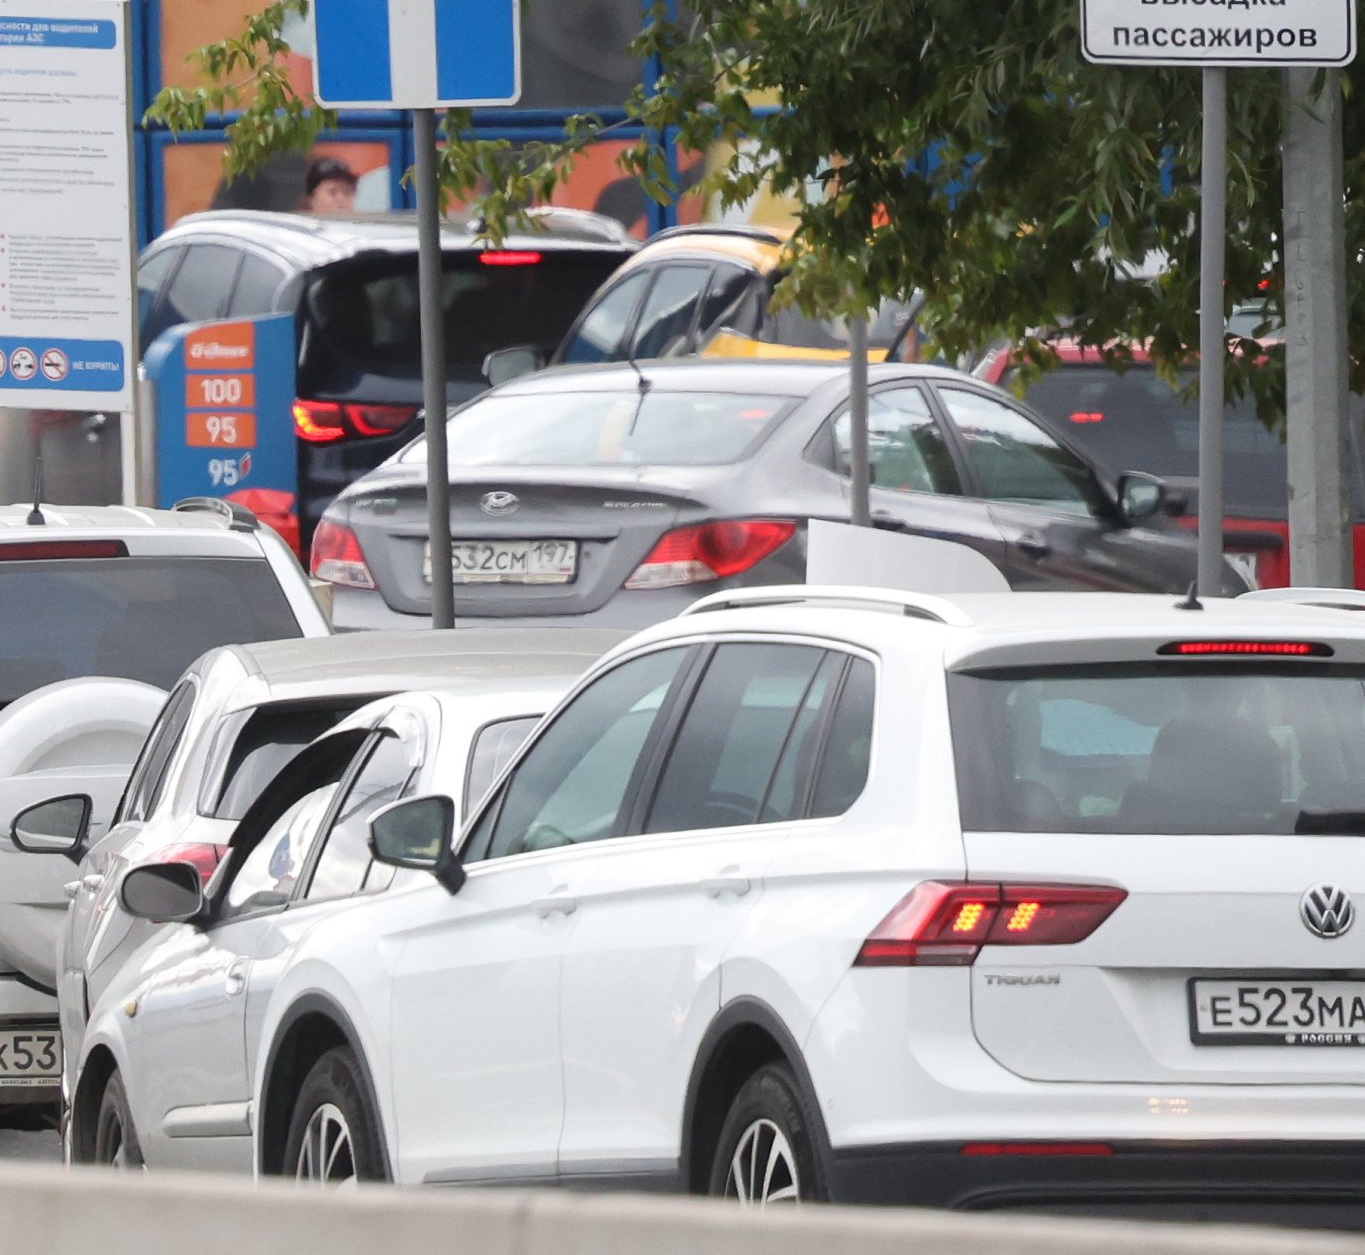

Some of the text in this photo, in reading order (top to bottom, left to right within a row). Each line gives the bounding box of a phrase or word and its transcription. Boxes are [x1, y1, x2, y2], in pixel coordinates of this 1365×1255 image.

[1112, 22, 1318, 53] пассажиров
[200, 378, 242, 405] 100
[205, 415, 238, 444] 95
[208, 458, 240, 487] 95
[451, 544, 527, 571] 532СМ
